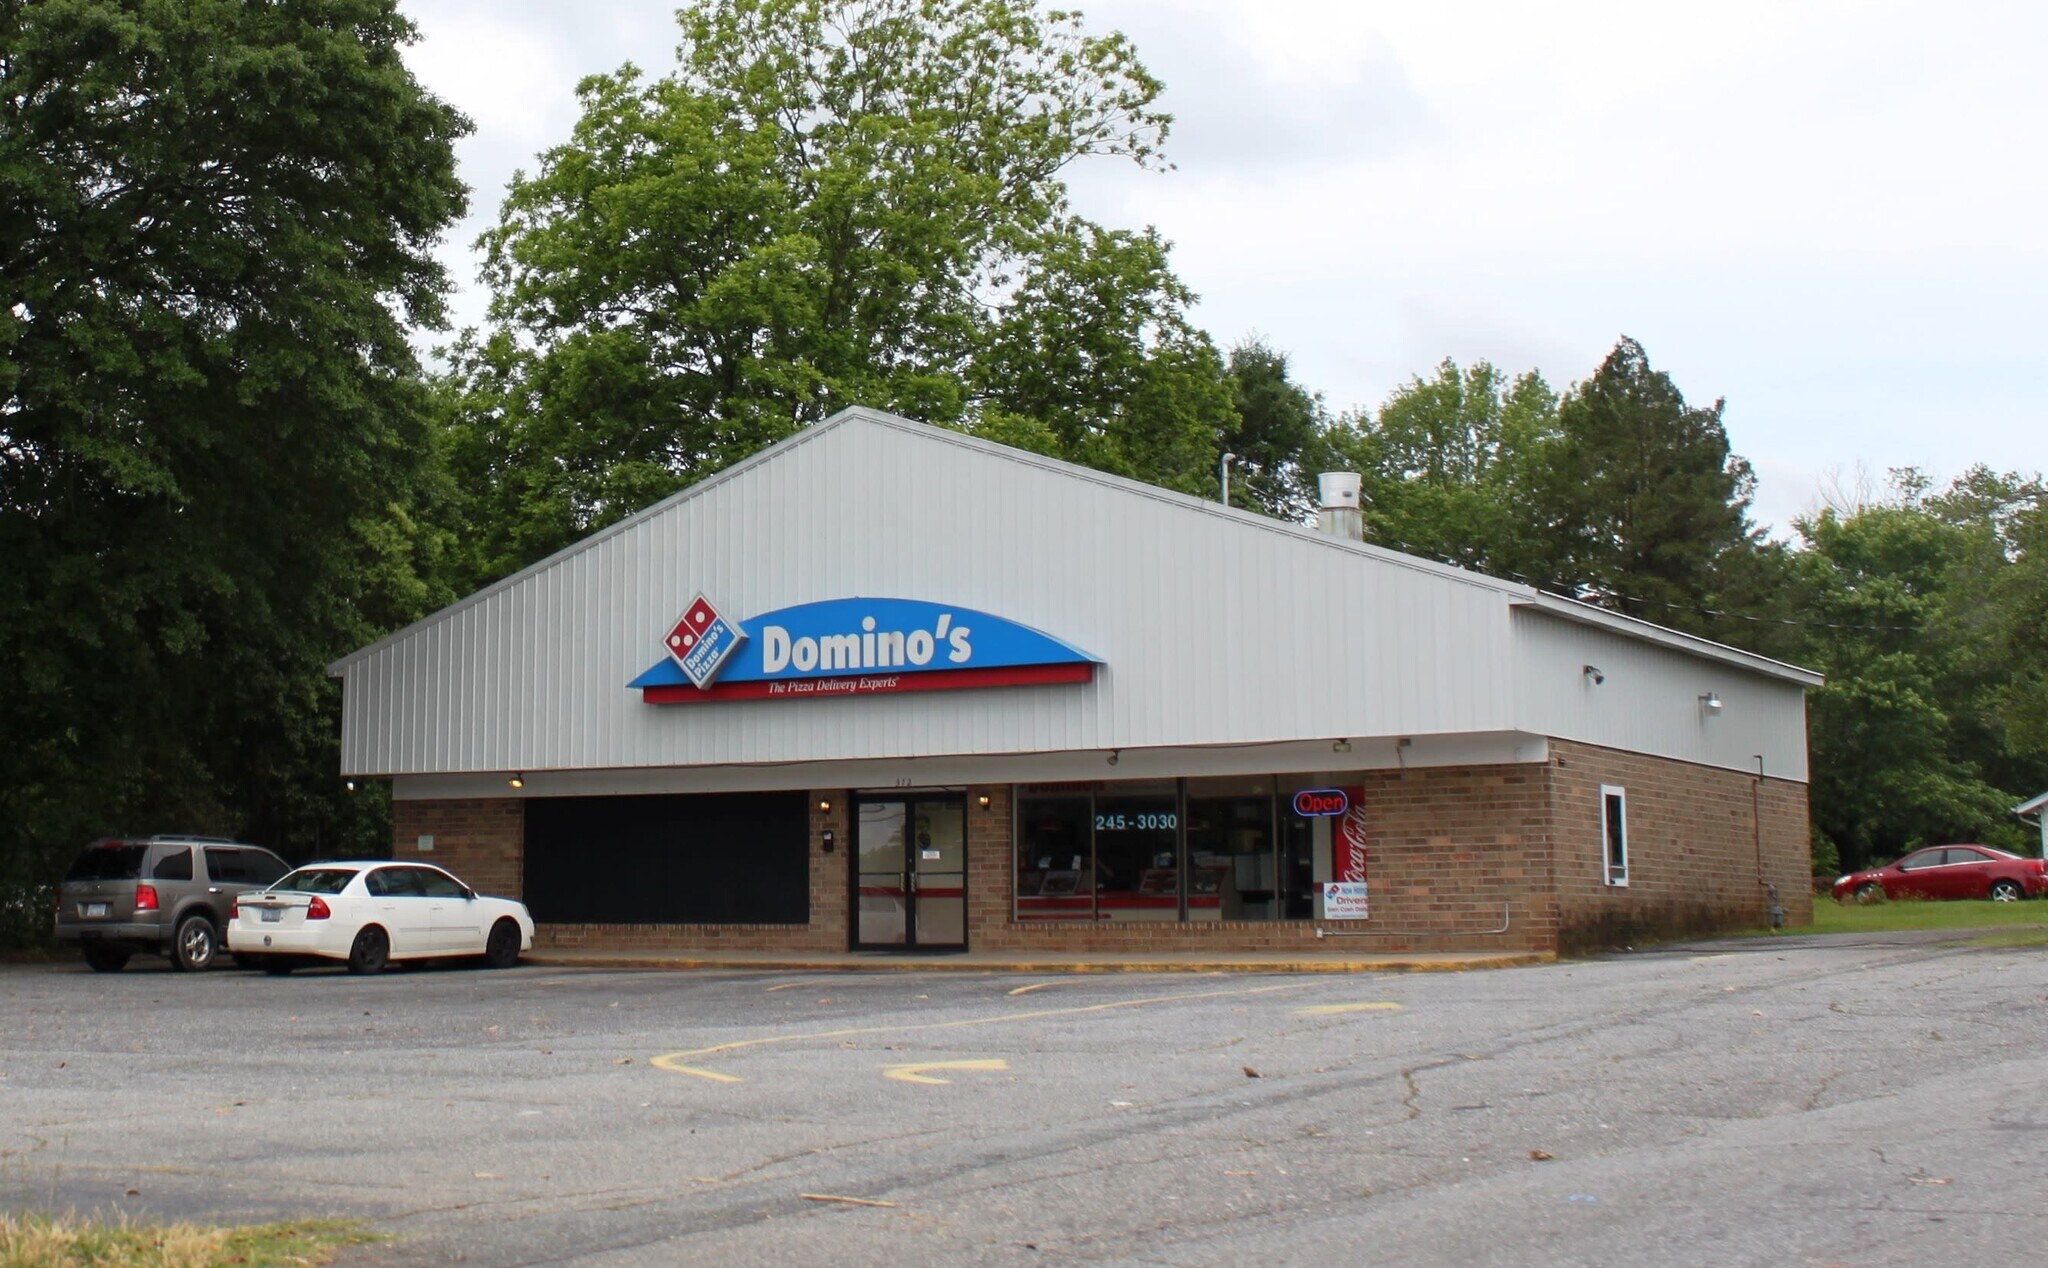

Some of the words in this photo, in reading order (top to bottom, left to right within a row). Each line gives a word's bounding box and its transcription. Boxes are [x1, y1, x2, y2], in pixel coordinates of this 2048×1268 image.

[685, 624, 724, 670] Domino's
[763, 613, 972, 673] Domino's
[693, 646, 720, 678] Pizza
[769, 682, 785, 693] The
[787, 681, 814, 692] Pizza
[817, 679, 857, 692] Delivery
[860, 677, 897, 690] Experts
[1299, 793, 1343, 812] Open
[1095, 814, 1177, 830] 245-3030
